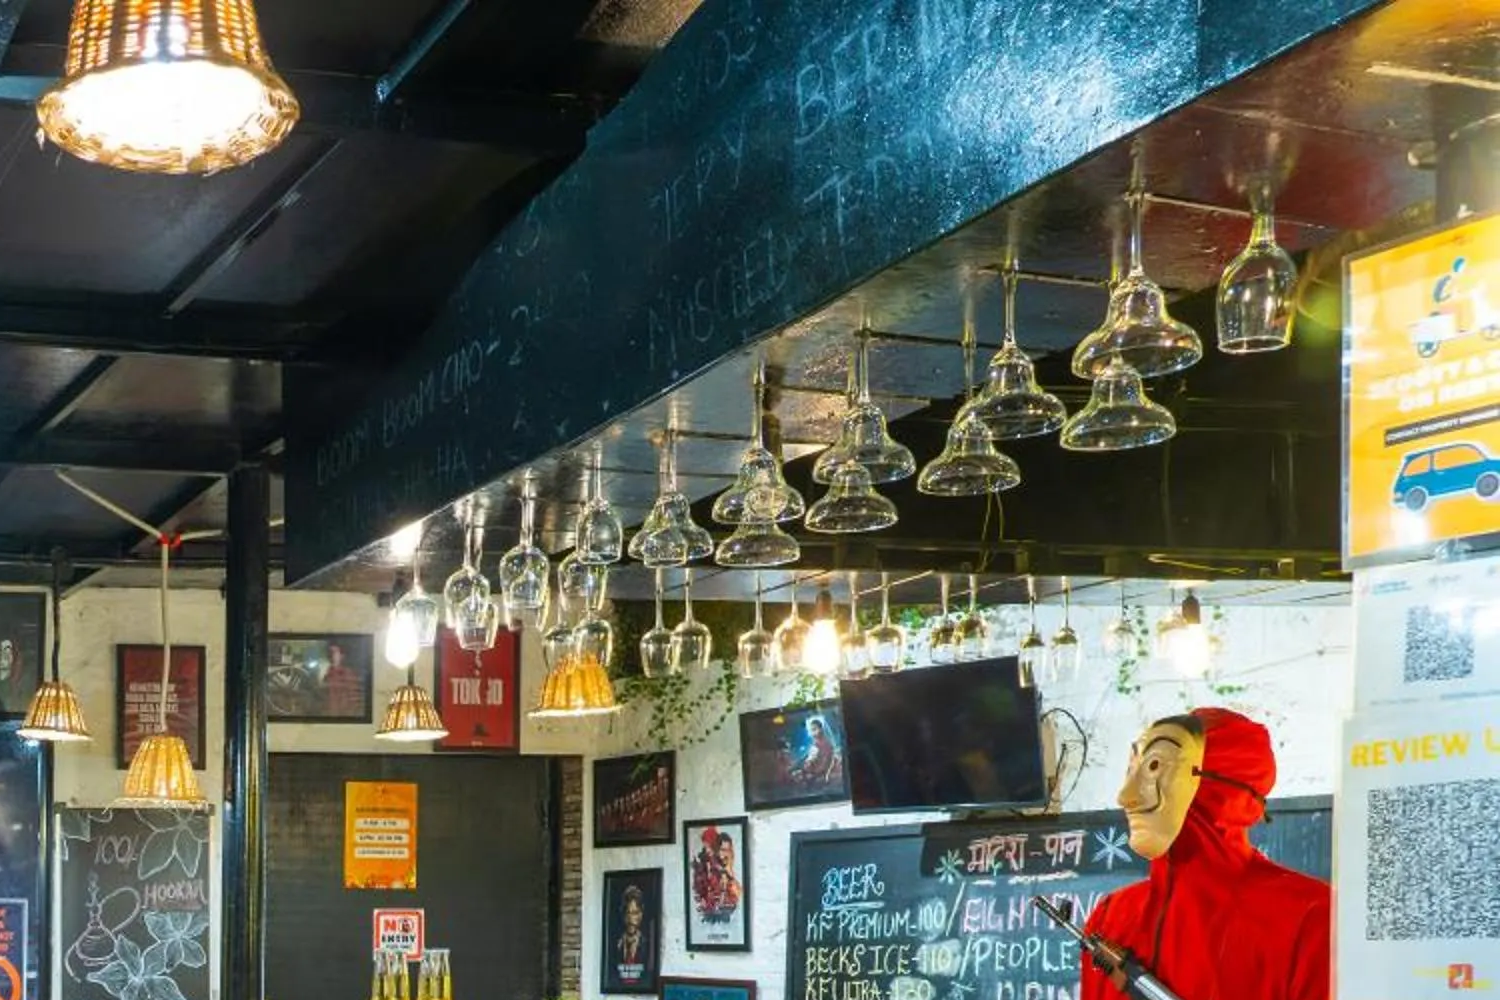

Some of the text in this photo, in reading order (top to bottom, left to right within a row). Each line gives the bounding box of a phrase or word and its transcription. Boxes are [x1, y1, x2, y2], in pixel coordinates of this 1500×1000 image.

[1350, 732, 1471, 768] REVIEW
[821, 863, 885, 907] BEER
[805, 944, 867, 977] BECKS
[868, 944, 911, 975] ICE
